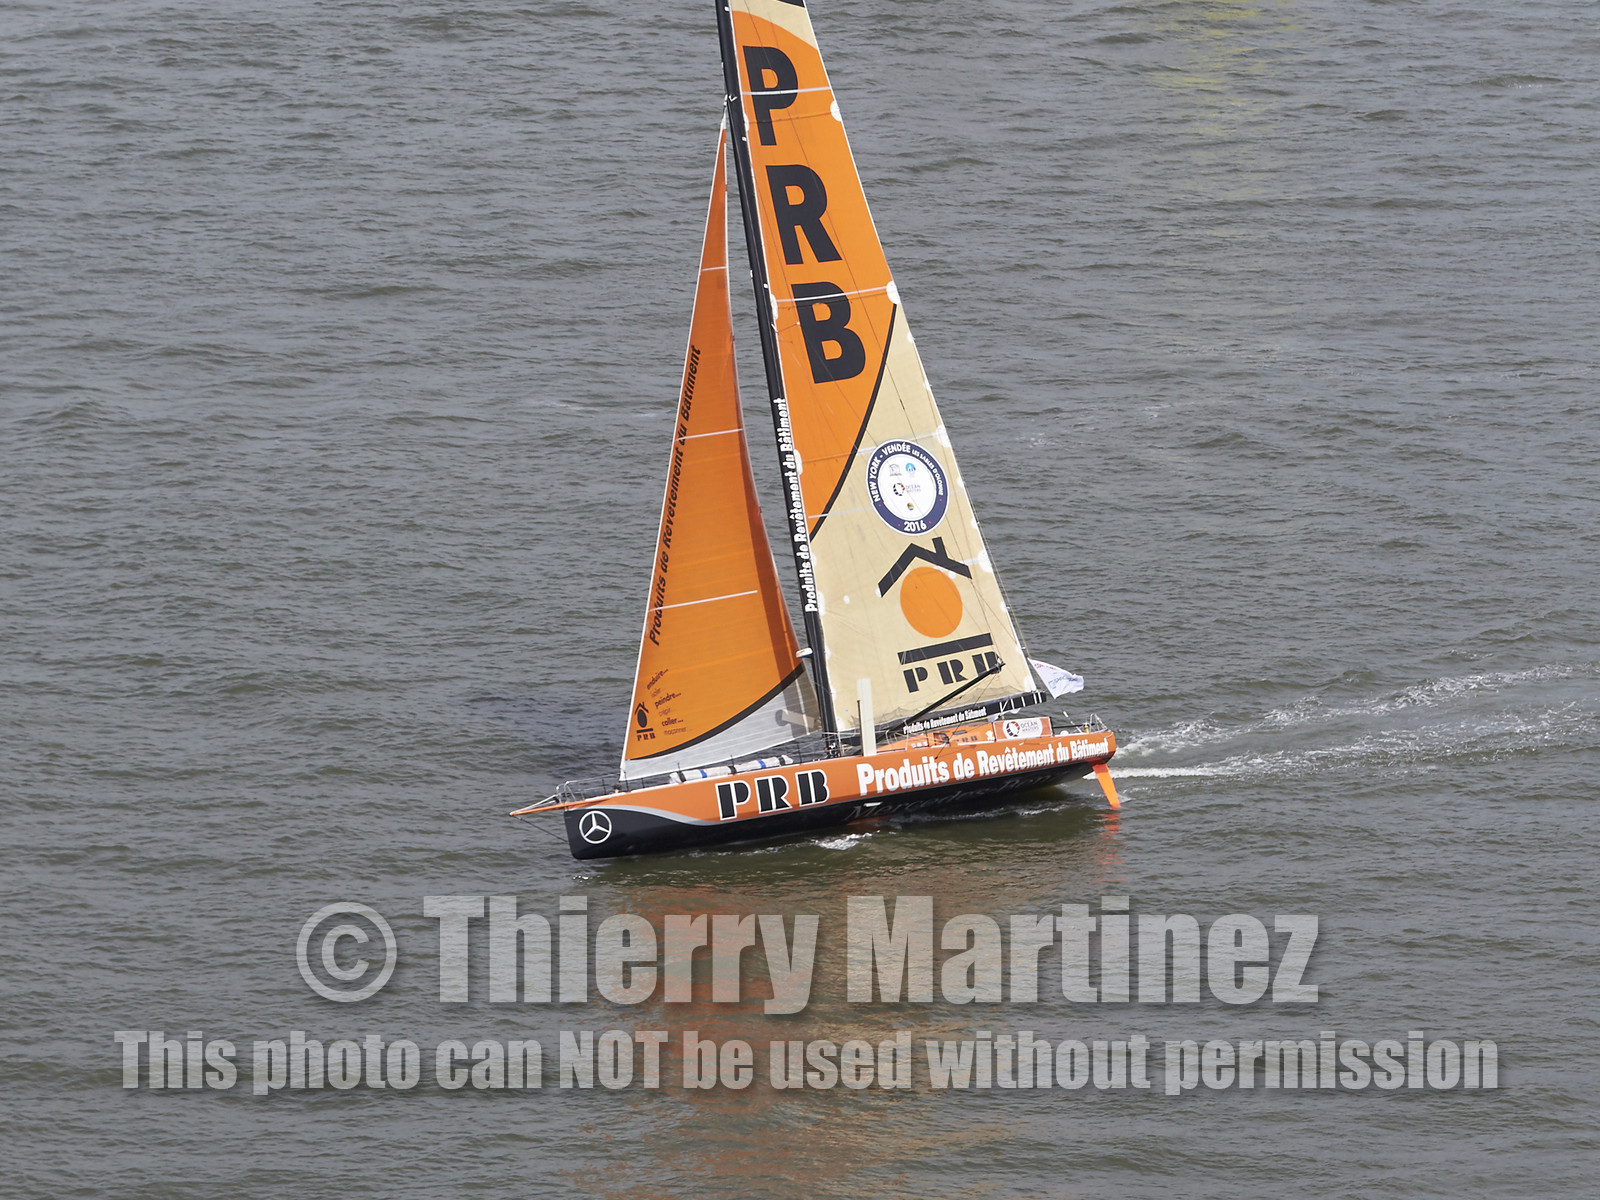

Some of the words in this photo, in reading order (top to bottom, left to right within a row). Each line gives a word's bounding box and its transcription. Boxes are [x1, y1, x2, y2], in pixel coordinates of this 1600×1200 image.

[742, 45, 866, 384] PRB
[773, 397, 793, 452] Bâtiment
[881, 441, 911, 456] VENDÉE
[782, 454, 796, 469] du
[869, 455, 882, 480] YORK
[869, 481, 881, 502] NEW
[784, 471, 807, 542] Revêtement
[649, 575, 667, 646] Produits
[660, 551, 669, 573] de
[677, 423, 688, 446] du
[903, 519, 927, 532] 2016
[796, 544, 810, 560] de
[799, 560, 818, 613] Produits
[636, 732, 656, 742] PRB
[1020, 720, 1038, 729] OCEAN
[856, 755, 950, 797] Produits
[952, 752, 975, 781] de
[976, 744, 1055, 777] Revêtement
[1056, 741, 1070, 762] du
[1069, 738, 1110, 760] Bâtiment
[715, 768, 831, 821] PRB
